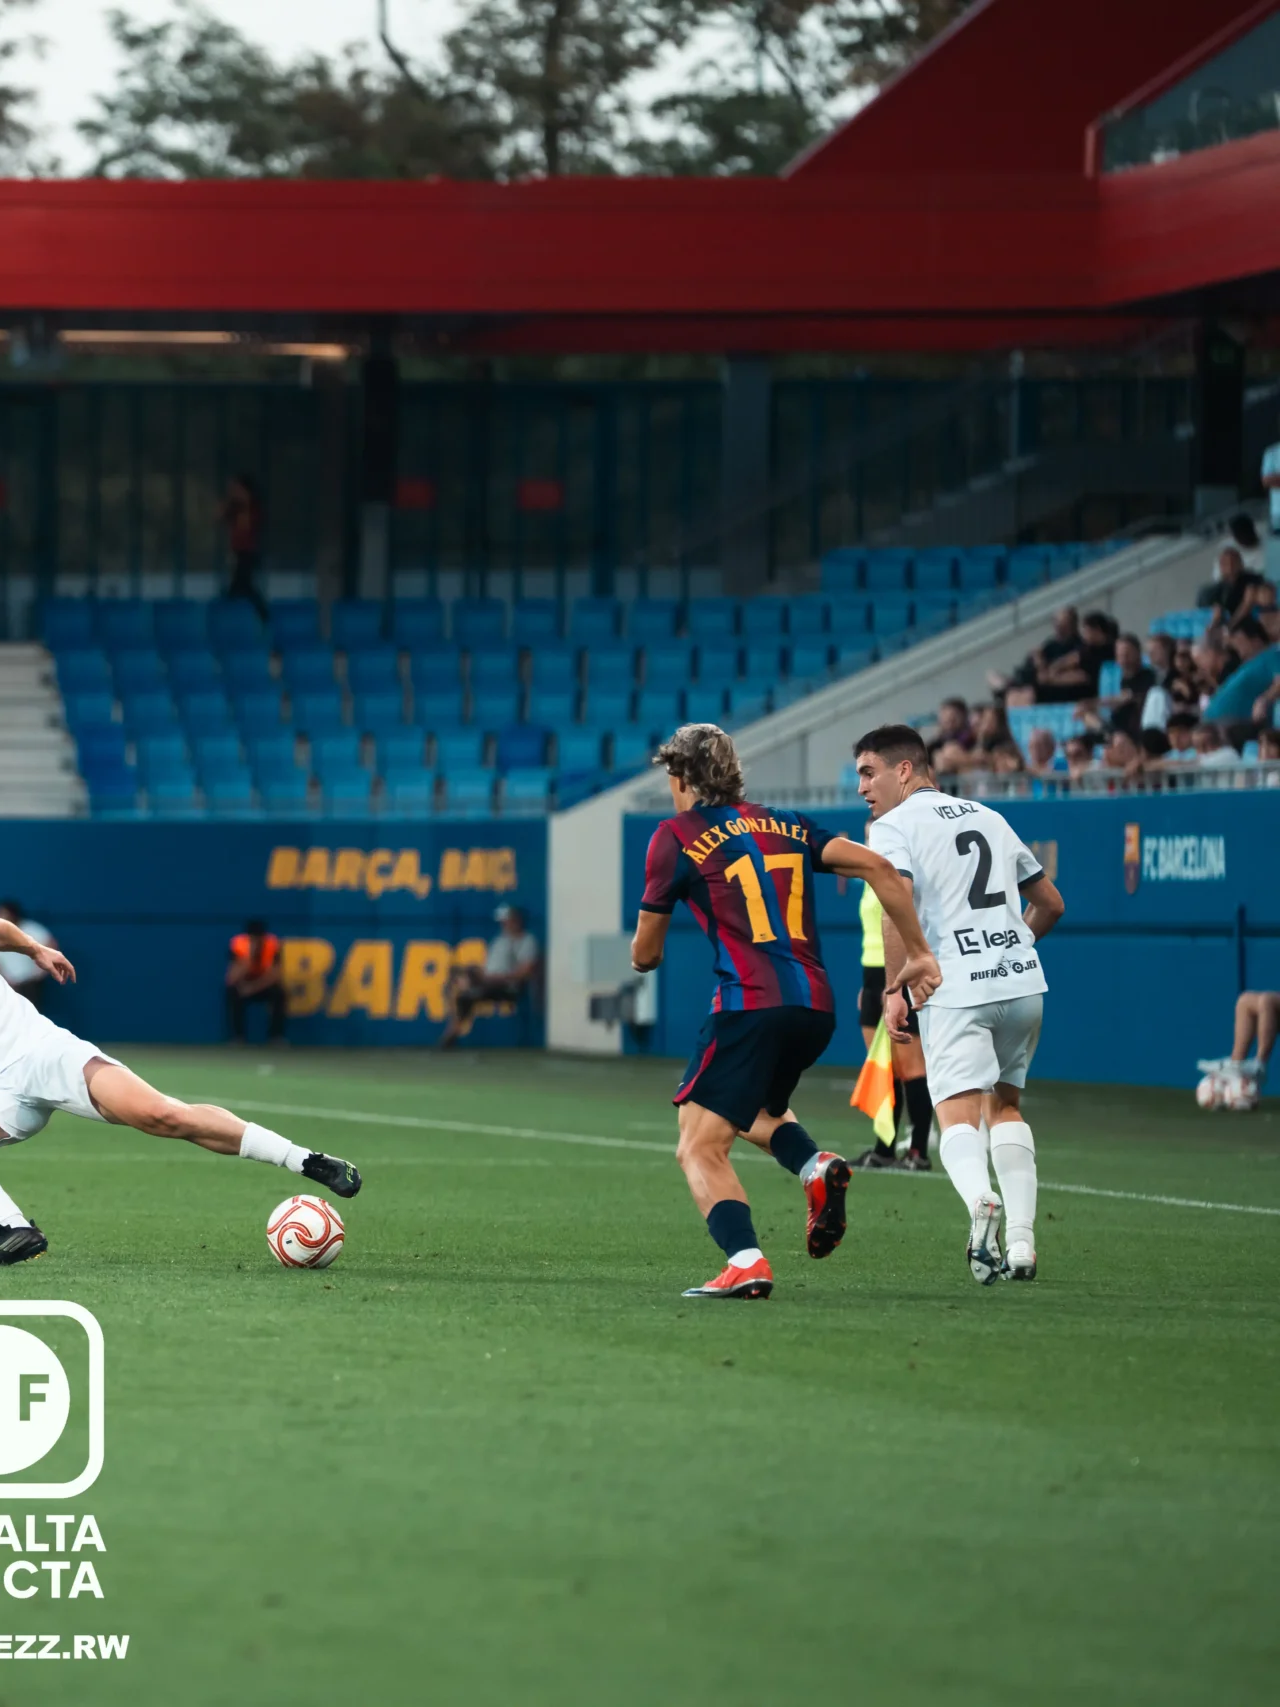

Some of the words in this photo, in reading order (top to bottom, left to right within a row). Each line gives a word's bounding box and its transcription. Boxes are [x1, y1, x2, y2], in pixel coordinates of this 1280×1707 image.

[932, 802, 980, 820] VELAZ
[682, 825, 730, 865] ÁLEX
[955, 829, 1007, 911] 2
[724, 853, 809, 944] 17
